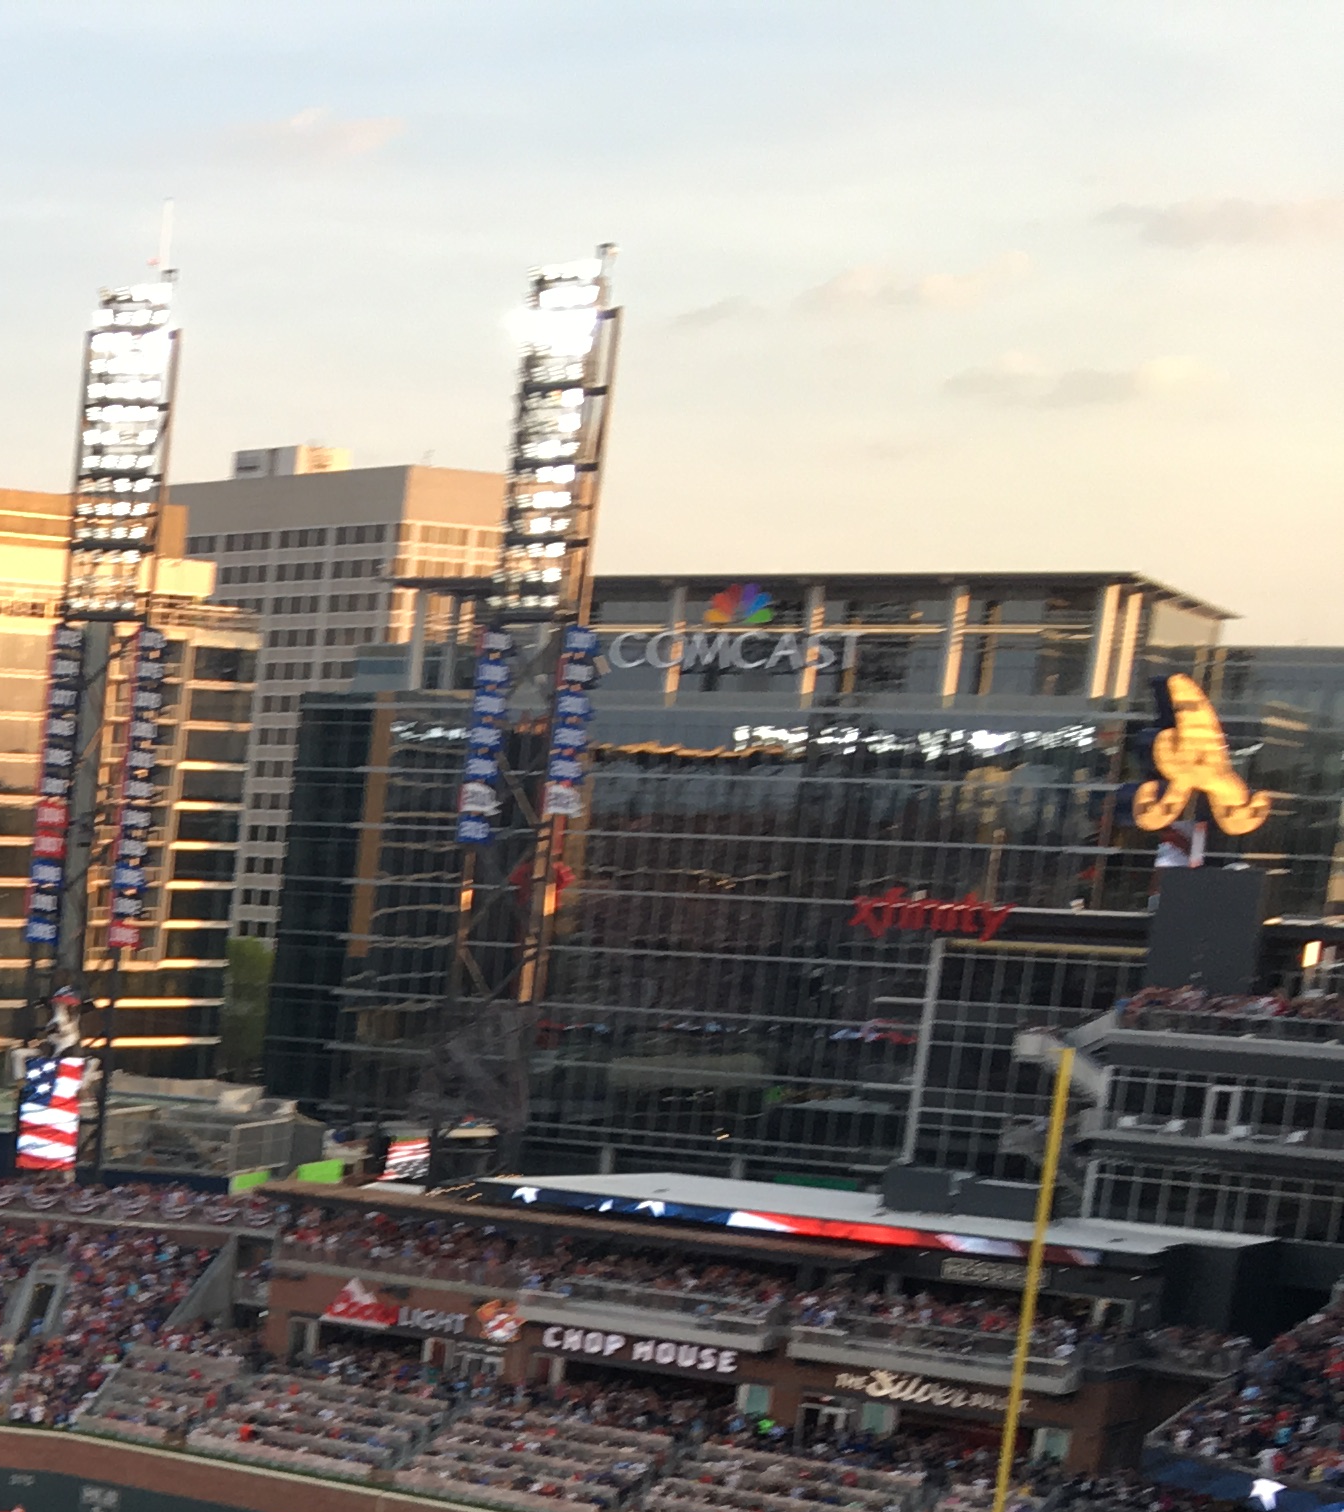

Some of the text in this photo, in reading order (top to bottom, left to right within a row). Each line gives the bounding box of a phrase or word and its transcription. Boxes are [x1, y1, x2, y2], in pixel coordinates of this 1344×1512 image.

[609, 630, 864, 670] COMCAST
[849, 886, 1018, 942] xfinity
[542, 1326, 739, 1373] CHOP HOUSE
